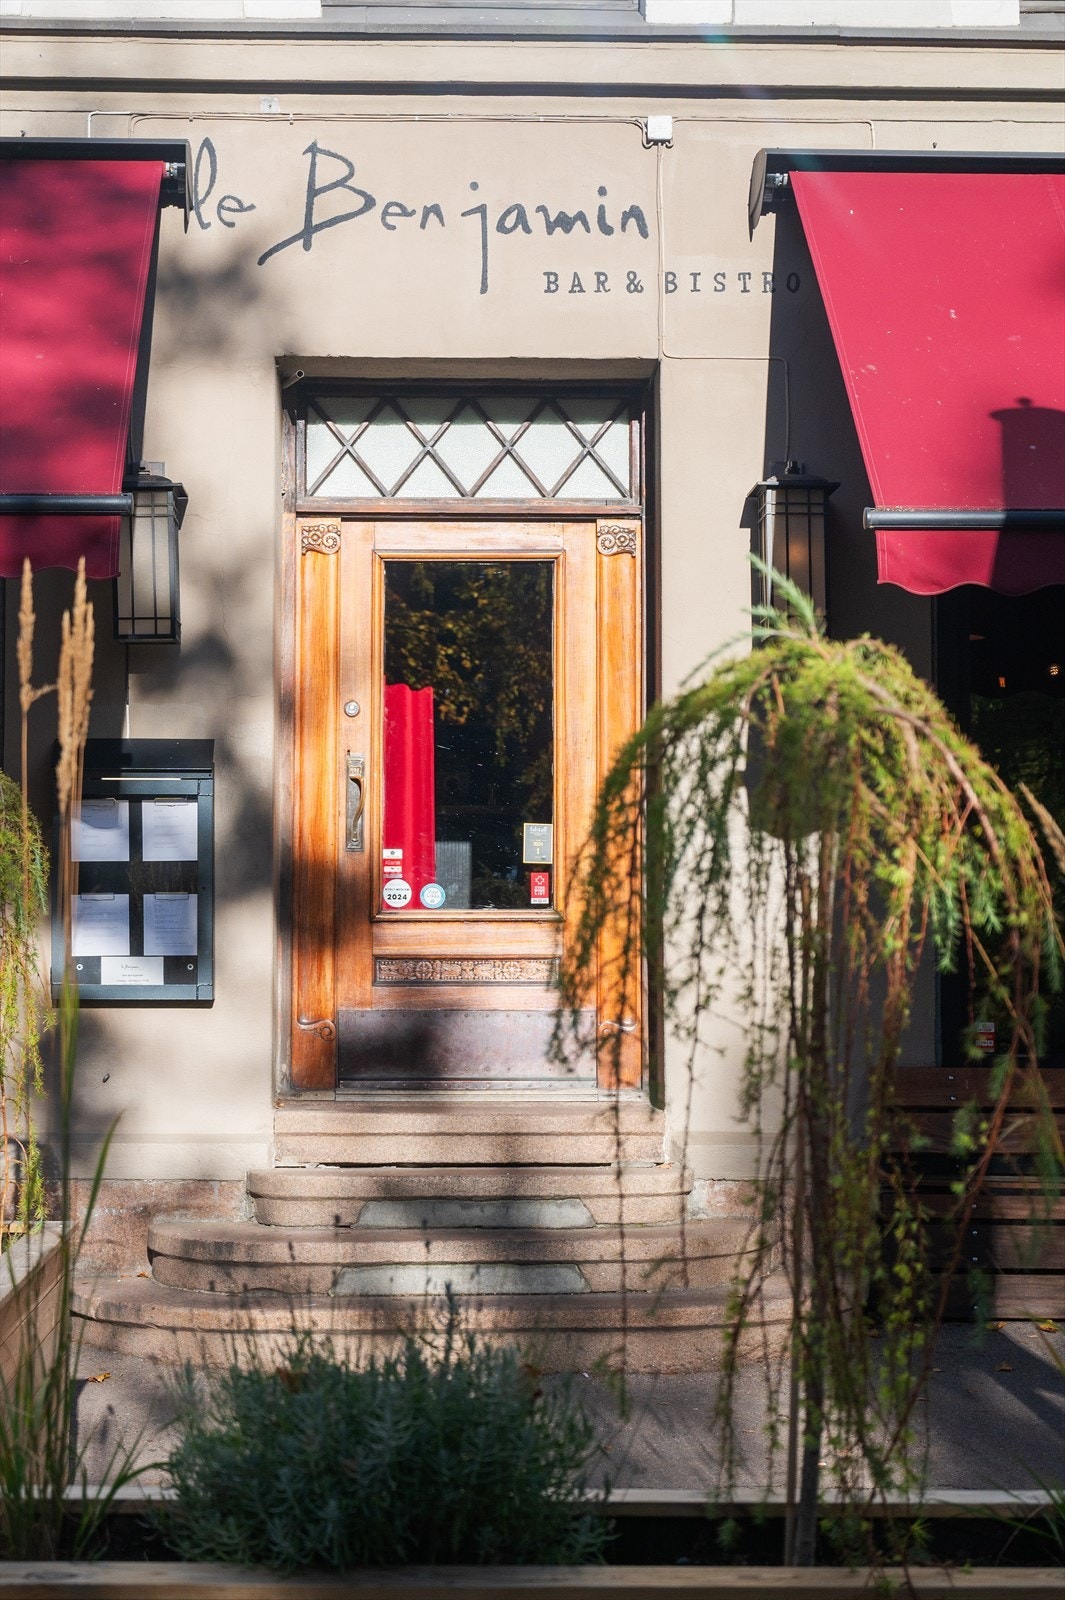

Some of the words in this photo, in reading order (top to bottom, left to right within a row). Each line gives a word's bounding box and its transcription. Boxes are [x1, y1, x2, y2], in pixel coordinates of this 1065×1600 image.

[192, 137, 256, 230] le
[257, 140, 649, 295] Benjamin
[543, 271, 611, 294] BAR
[626, 270, 645, 294] &
[665, 271, 801, 294] BISTRO
